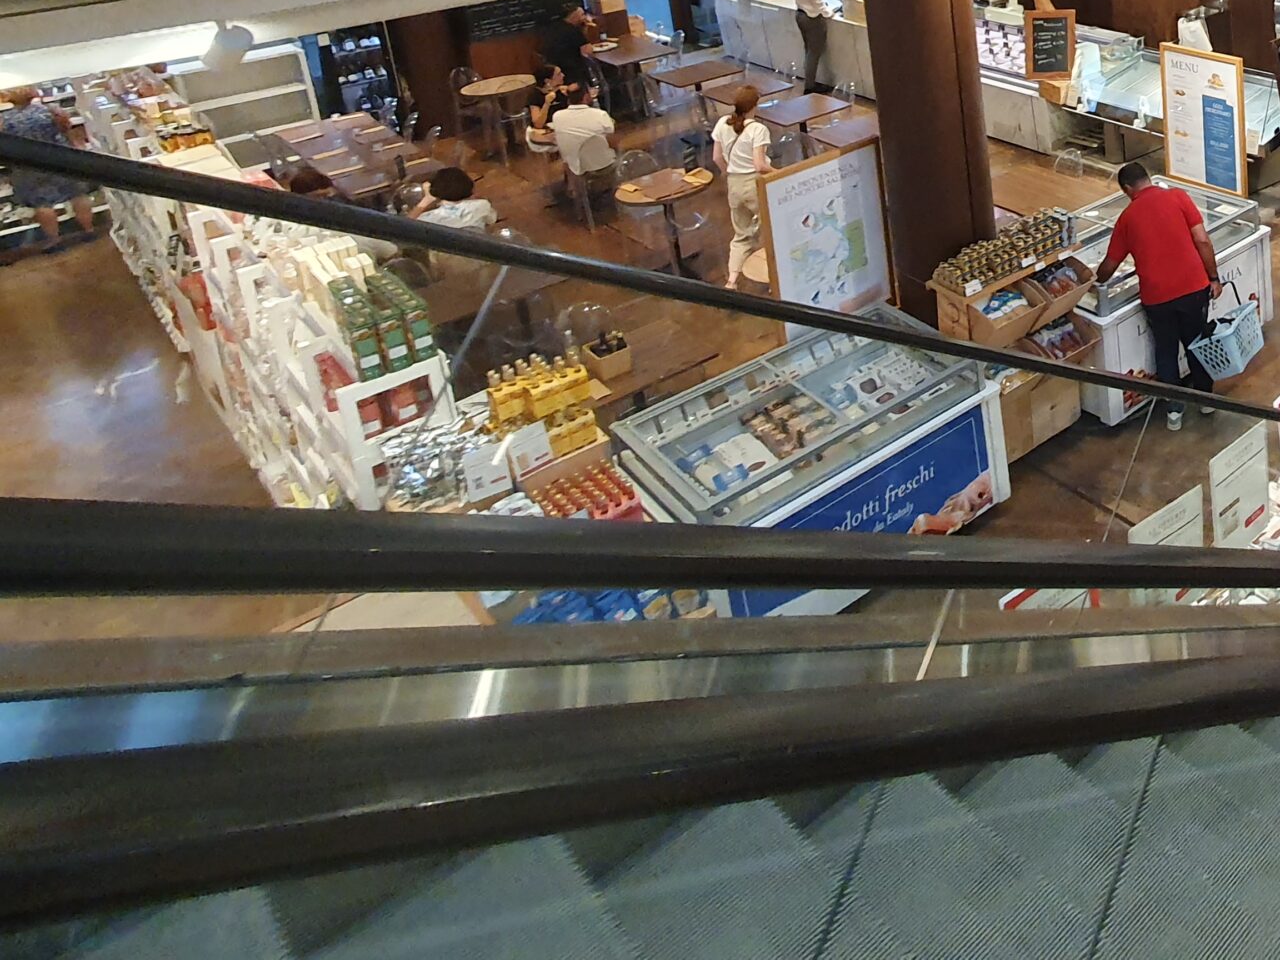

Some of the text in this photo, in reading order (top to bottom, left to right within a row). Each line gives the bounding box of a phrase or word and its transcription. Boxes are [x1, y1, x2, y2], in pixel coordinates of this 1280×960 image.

[1170, 58, 1199, 74] MENU
[882, 460, 936, 516] freschi
[886, 502, 915, 526] Eataly
